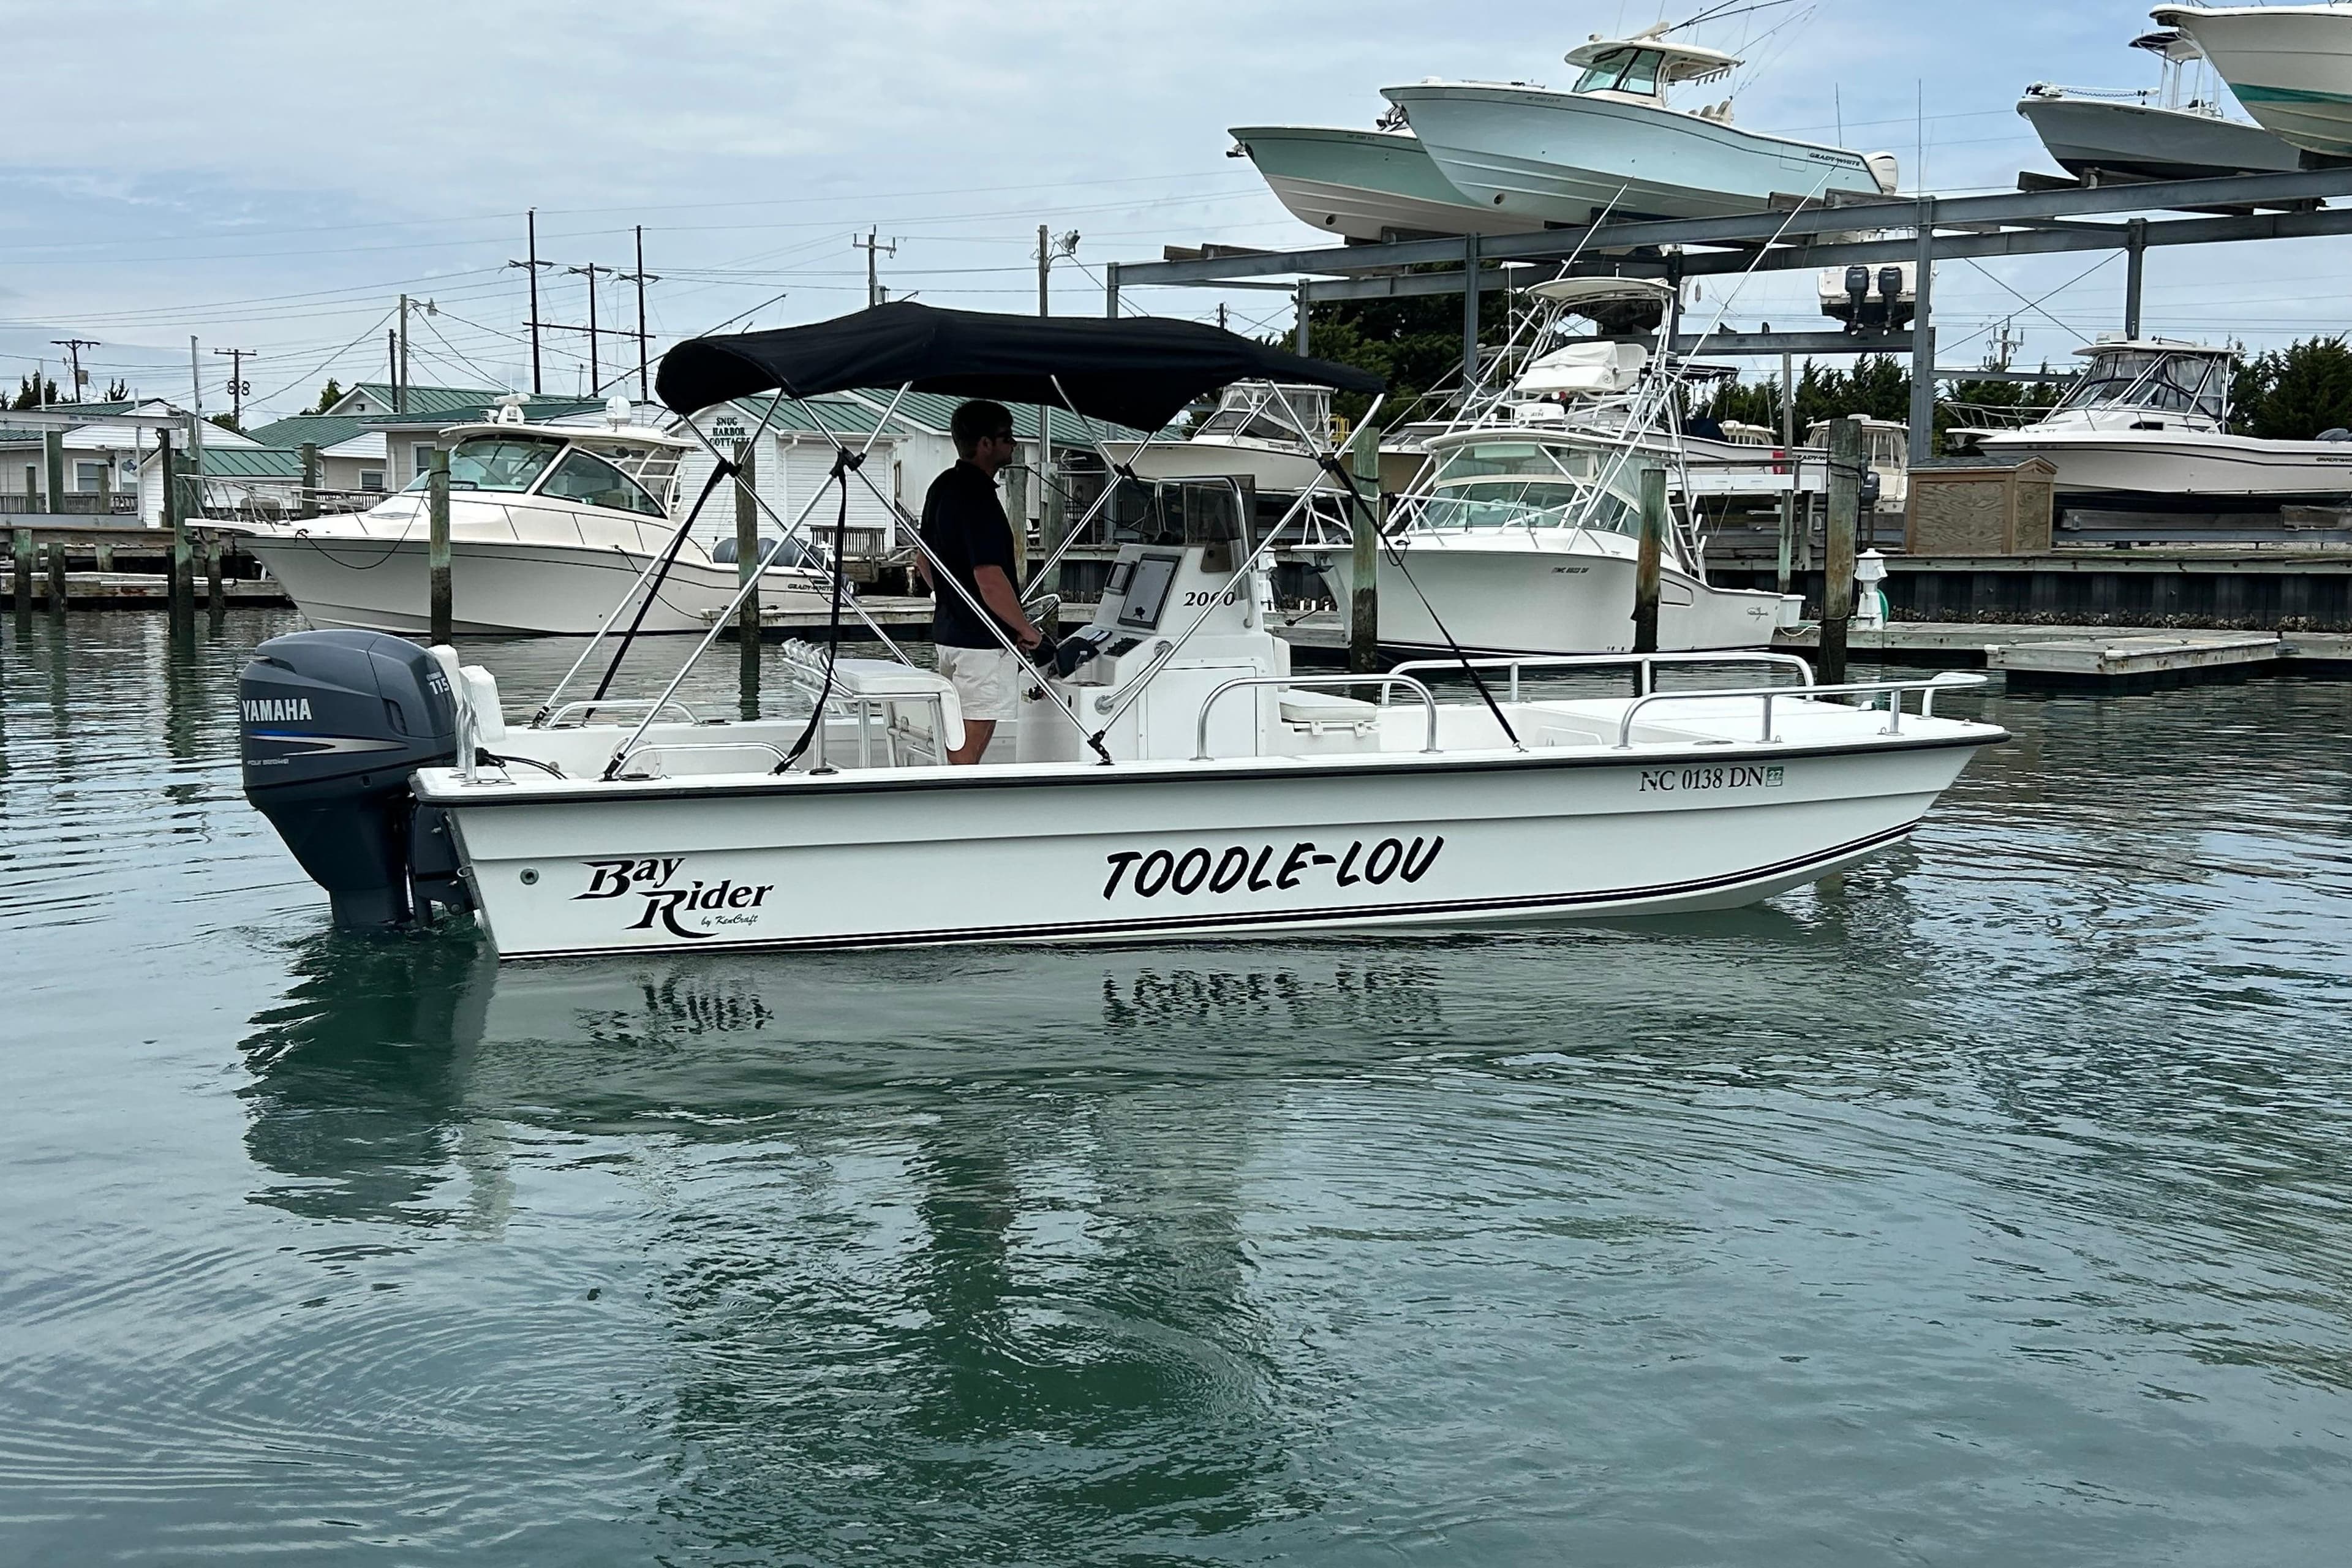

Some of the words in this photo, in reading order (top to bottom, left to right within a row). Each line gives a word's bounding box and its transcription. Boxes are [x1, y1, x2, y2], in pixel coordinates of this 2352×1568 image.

[712, 427, 746, 436] HARBOR
[716, 417, 738, 426] SNUG
[429, 677, 450, 695] 115
[241, 698, 312, 722] YAMAHA
[1639, 770, 1675, 791] NC
[1681, 767, 1723, 790] 0138
[1728, 766, 1765, 788] DN
[568, 858, 686, 900] Bay
[1102, 835, 1444, 900] TOODLE-LOU
[621, 880, 775, 938] Rider
[715, 913, 758, 925] KenCraft
